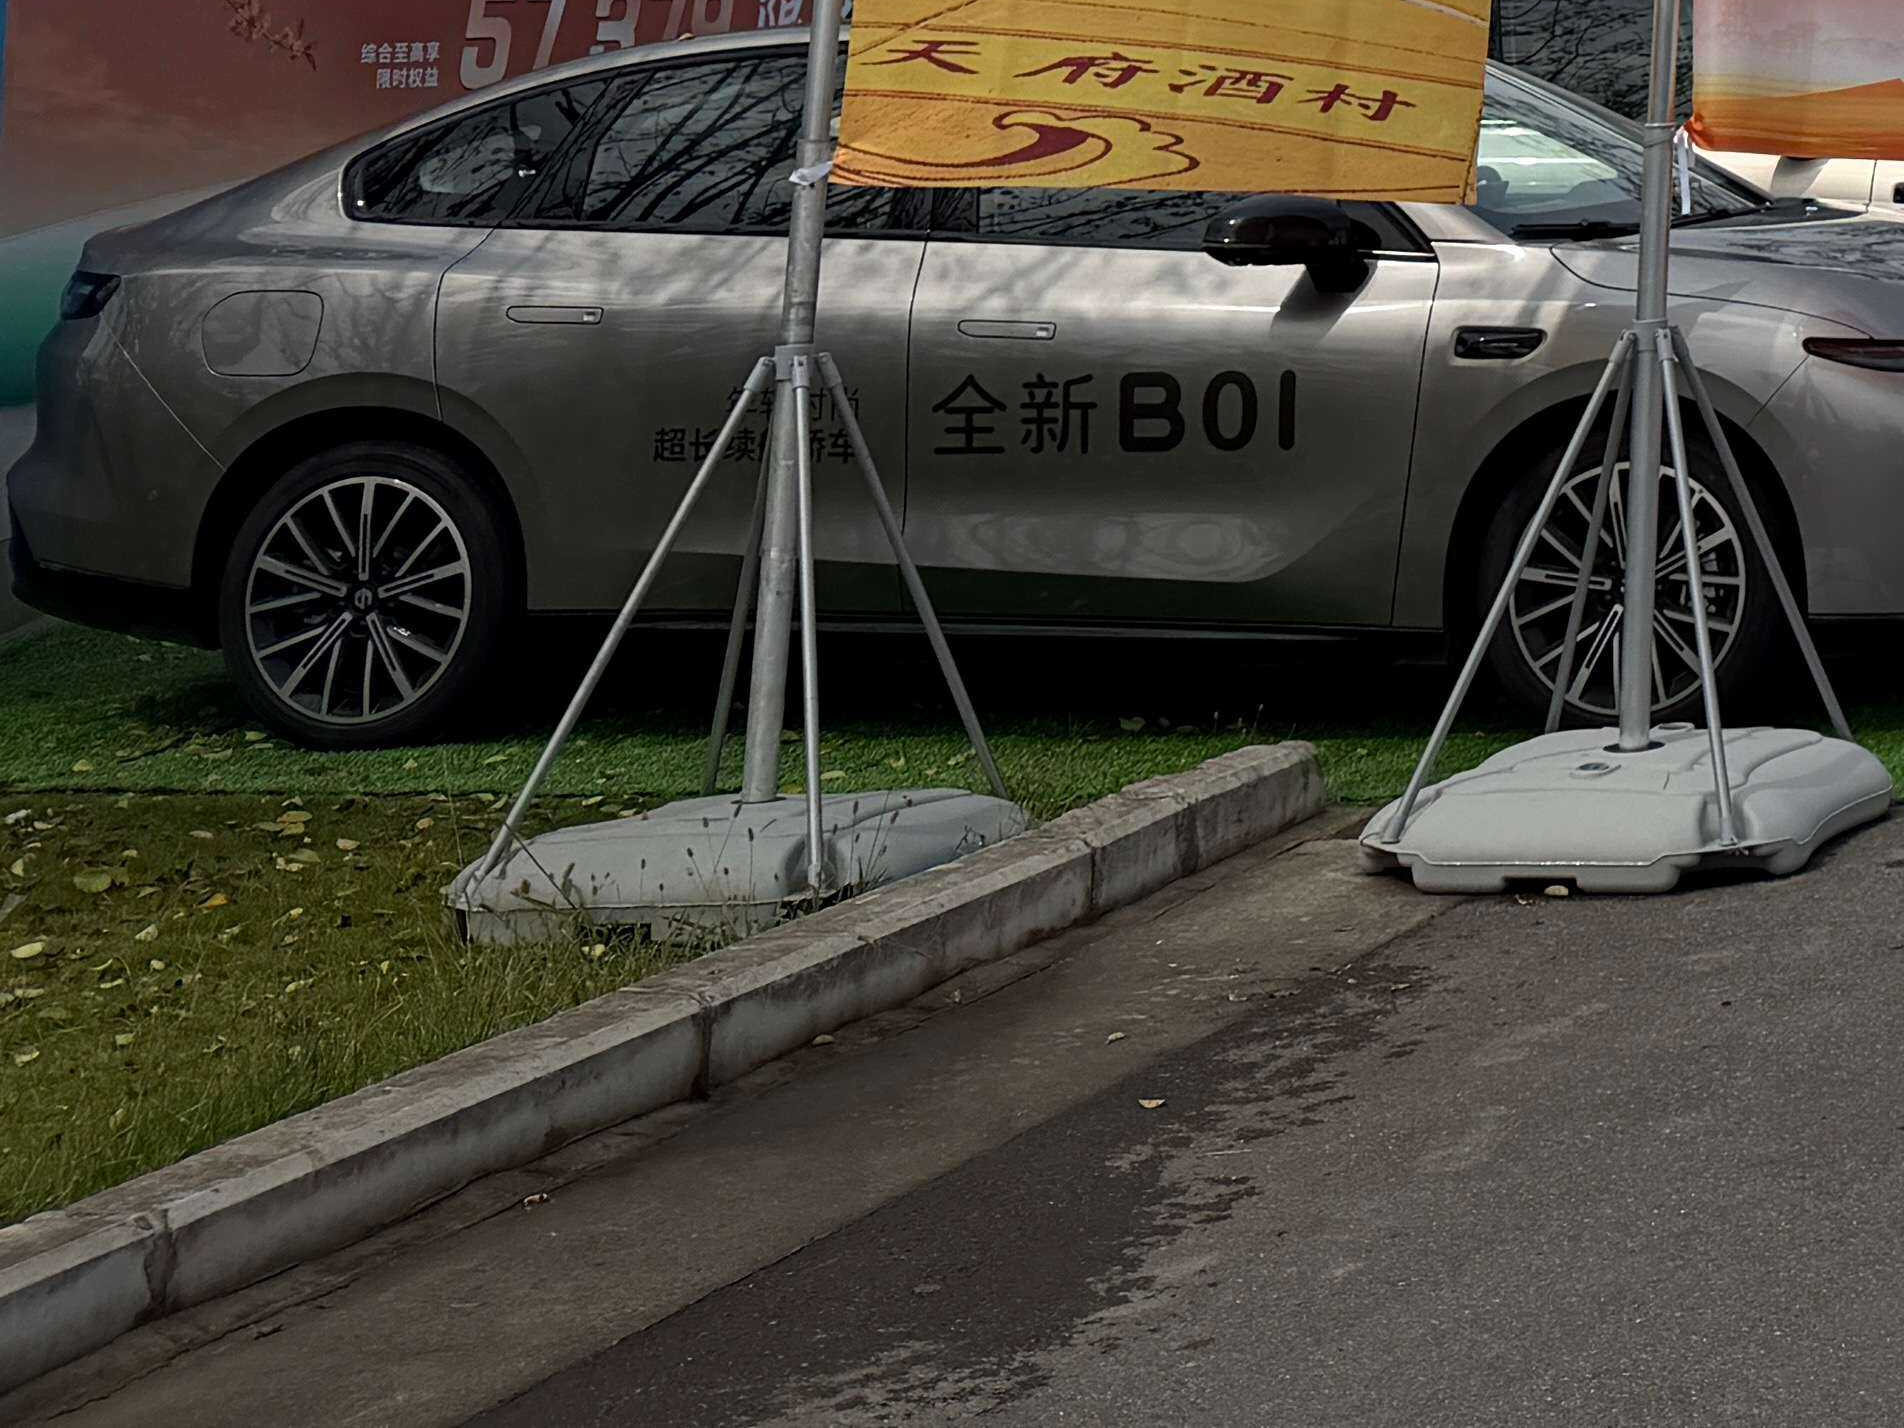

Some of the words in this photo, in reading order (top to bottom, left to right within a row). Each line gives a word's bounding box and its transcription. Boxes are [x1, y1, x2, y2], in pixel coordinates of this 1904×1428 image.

[375, 66, 440, 89] 限时权益
[861, 39, 1418, 122] 天府酒村
